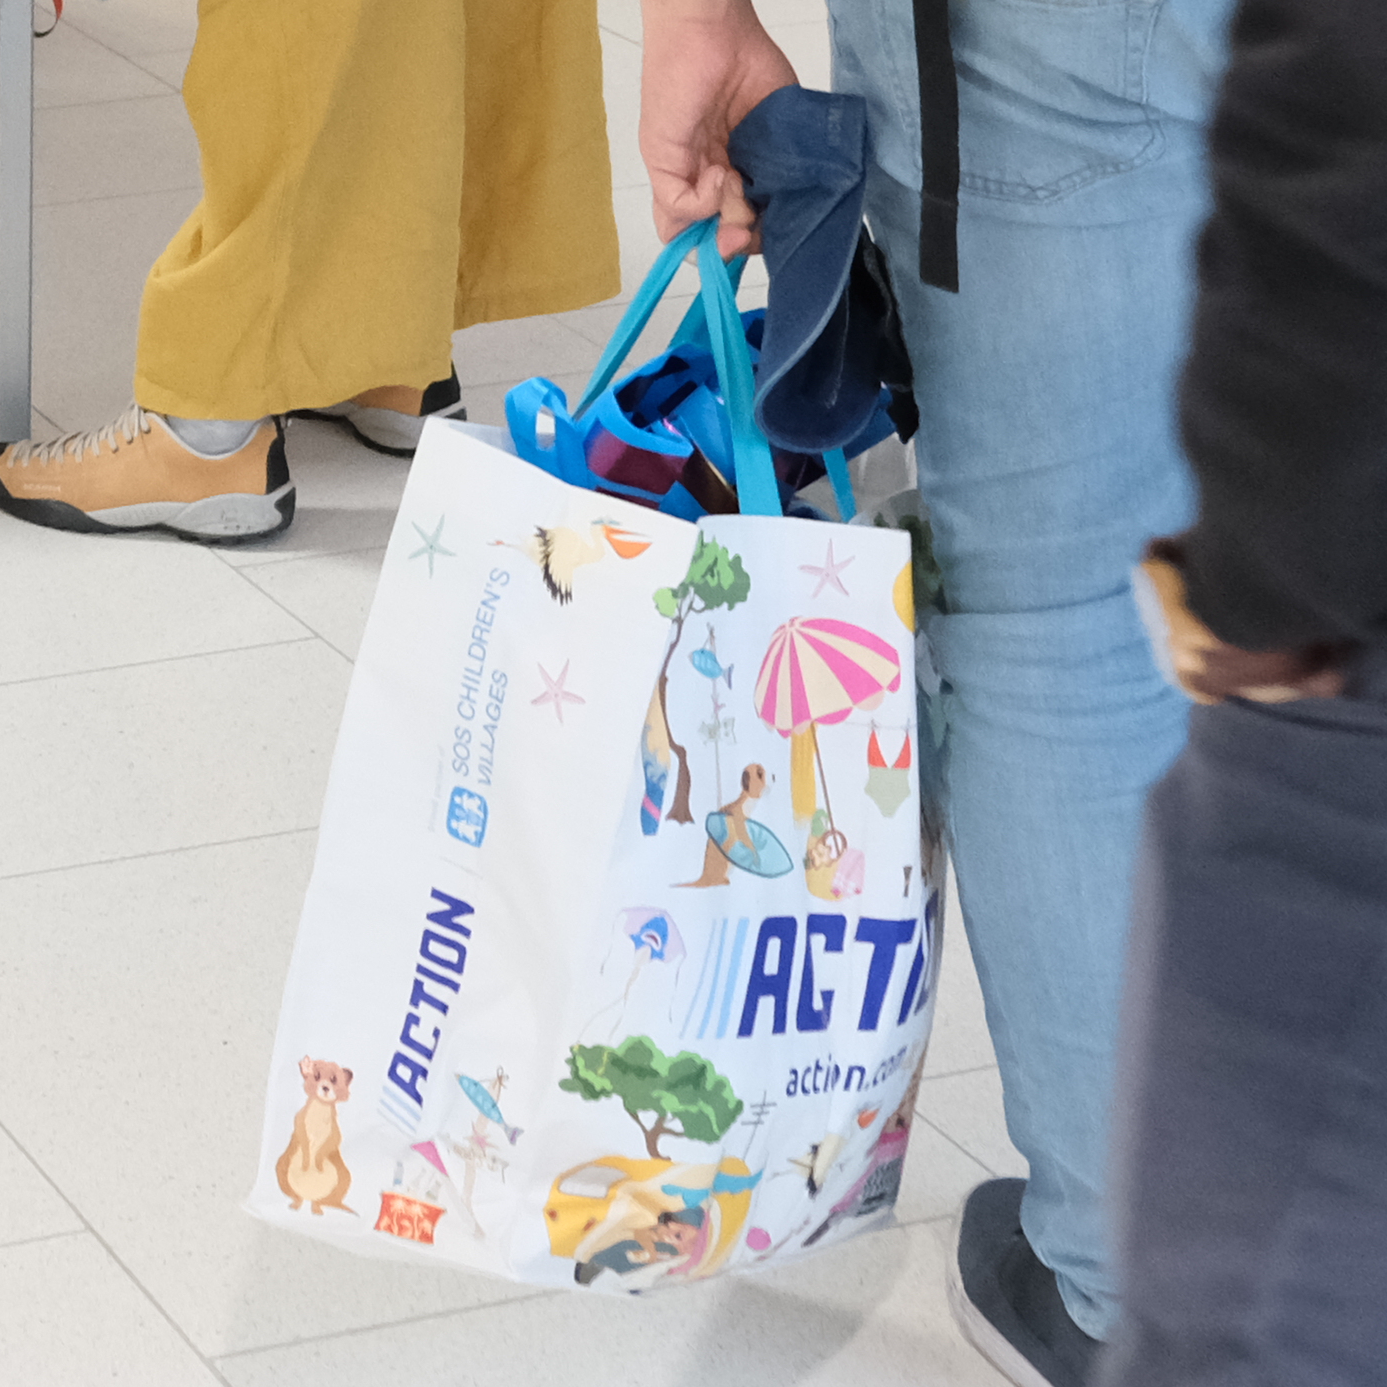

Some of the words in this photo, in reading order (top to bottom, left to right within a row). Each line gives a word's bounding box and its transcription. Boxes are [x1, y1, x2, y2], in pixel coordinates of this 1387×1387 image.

[457, 567, 510, 722] CHILDREN'S
[452, 725, 473, 778] SOS
[477, 669, 509, 787] VILLAGES
[387, 886, 476, 1109] ACTION
[736, 897, 938, 1038] ACTI
